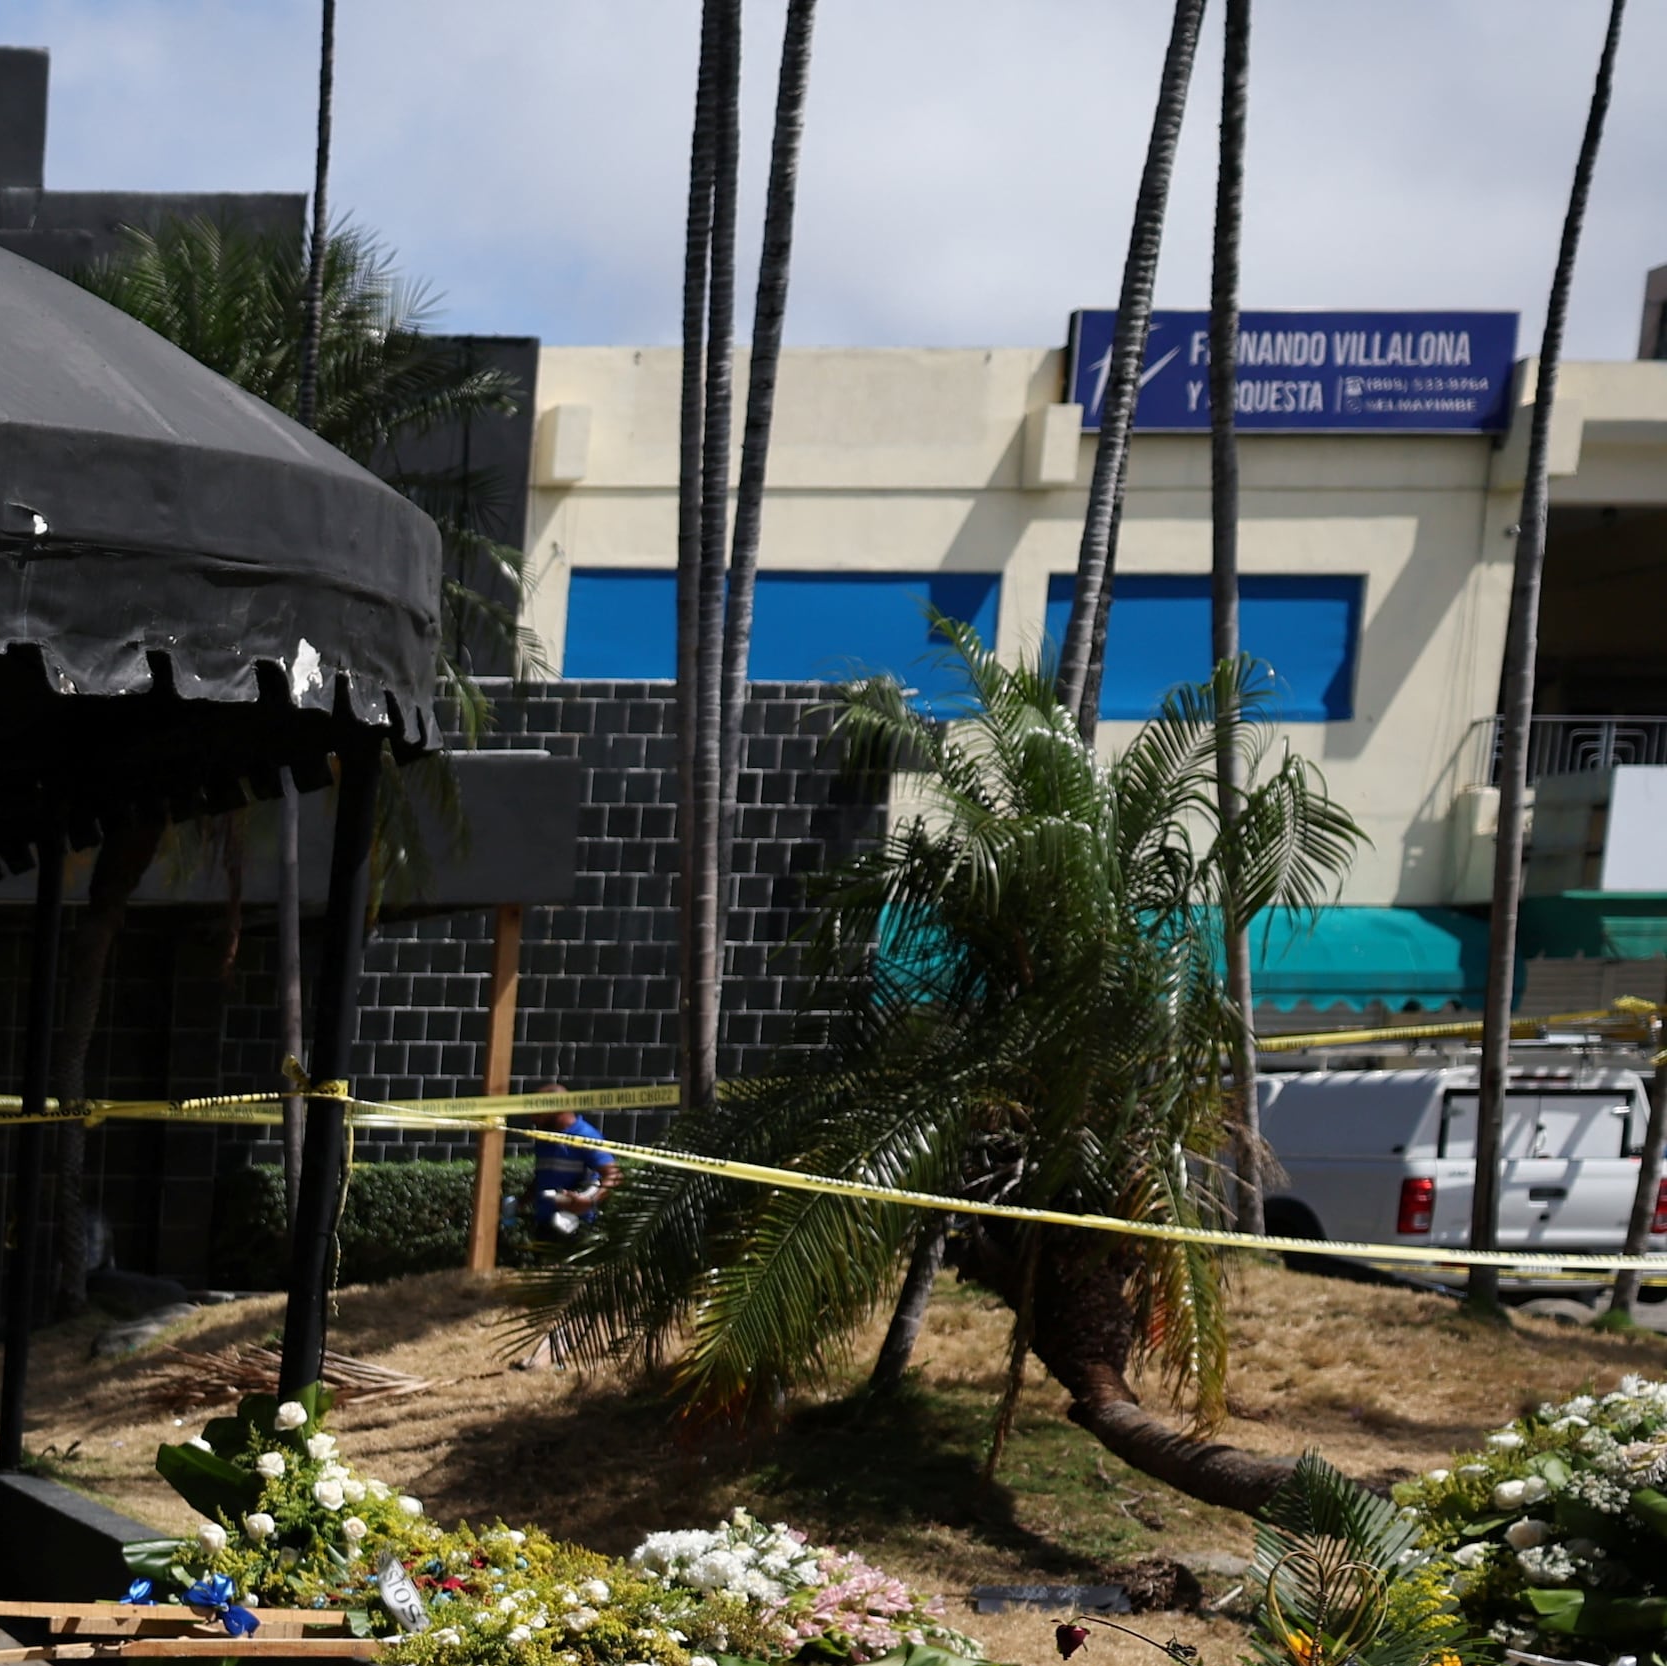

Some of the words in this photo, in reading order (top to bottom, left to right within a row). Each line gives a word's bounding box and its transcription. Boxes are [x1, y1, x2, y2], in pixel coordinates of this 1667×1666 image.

[1190, 331, 1326, 366] FNANDO
[1333, 331, 1471, 366] VILLALONA
[1187, 381, 1201, 412] Y
[1205, 380, 1324, 412] QUESTA
